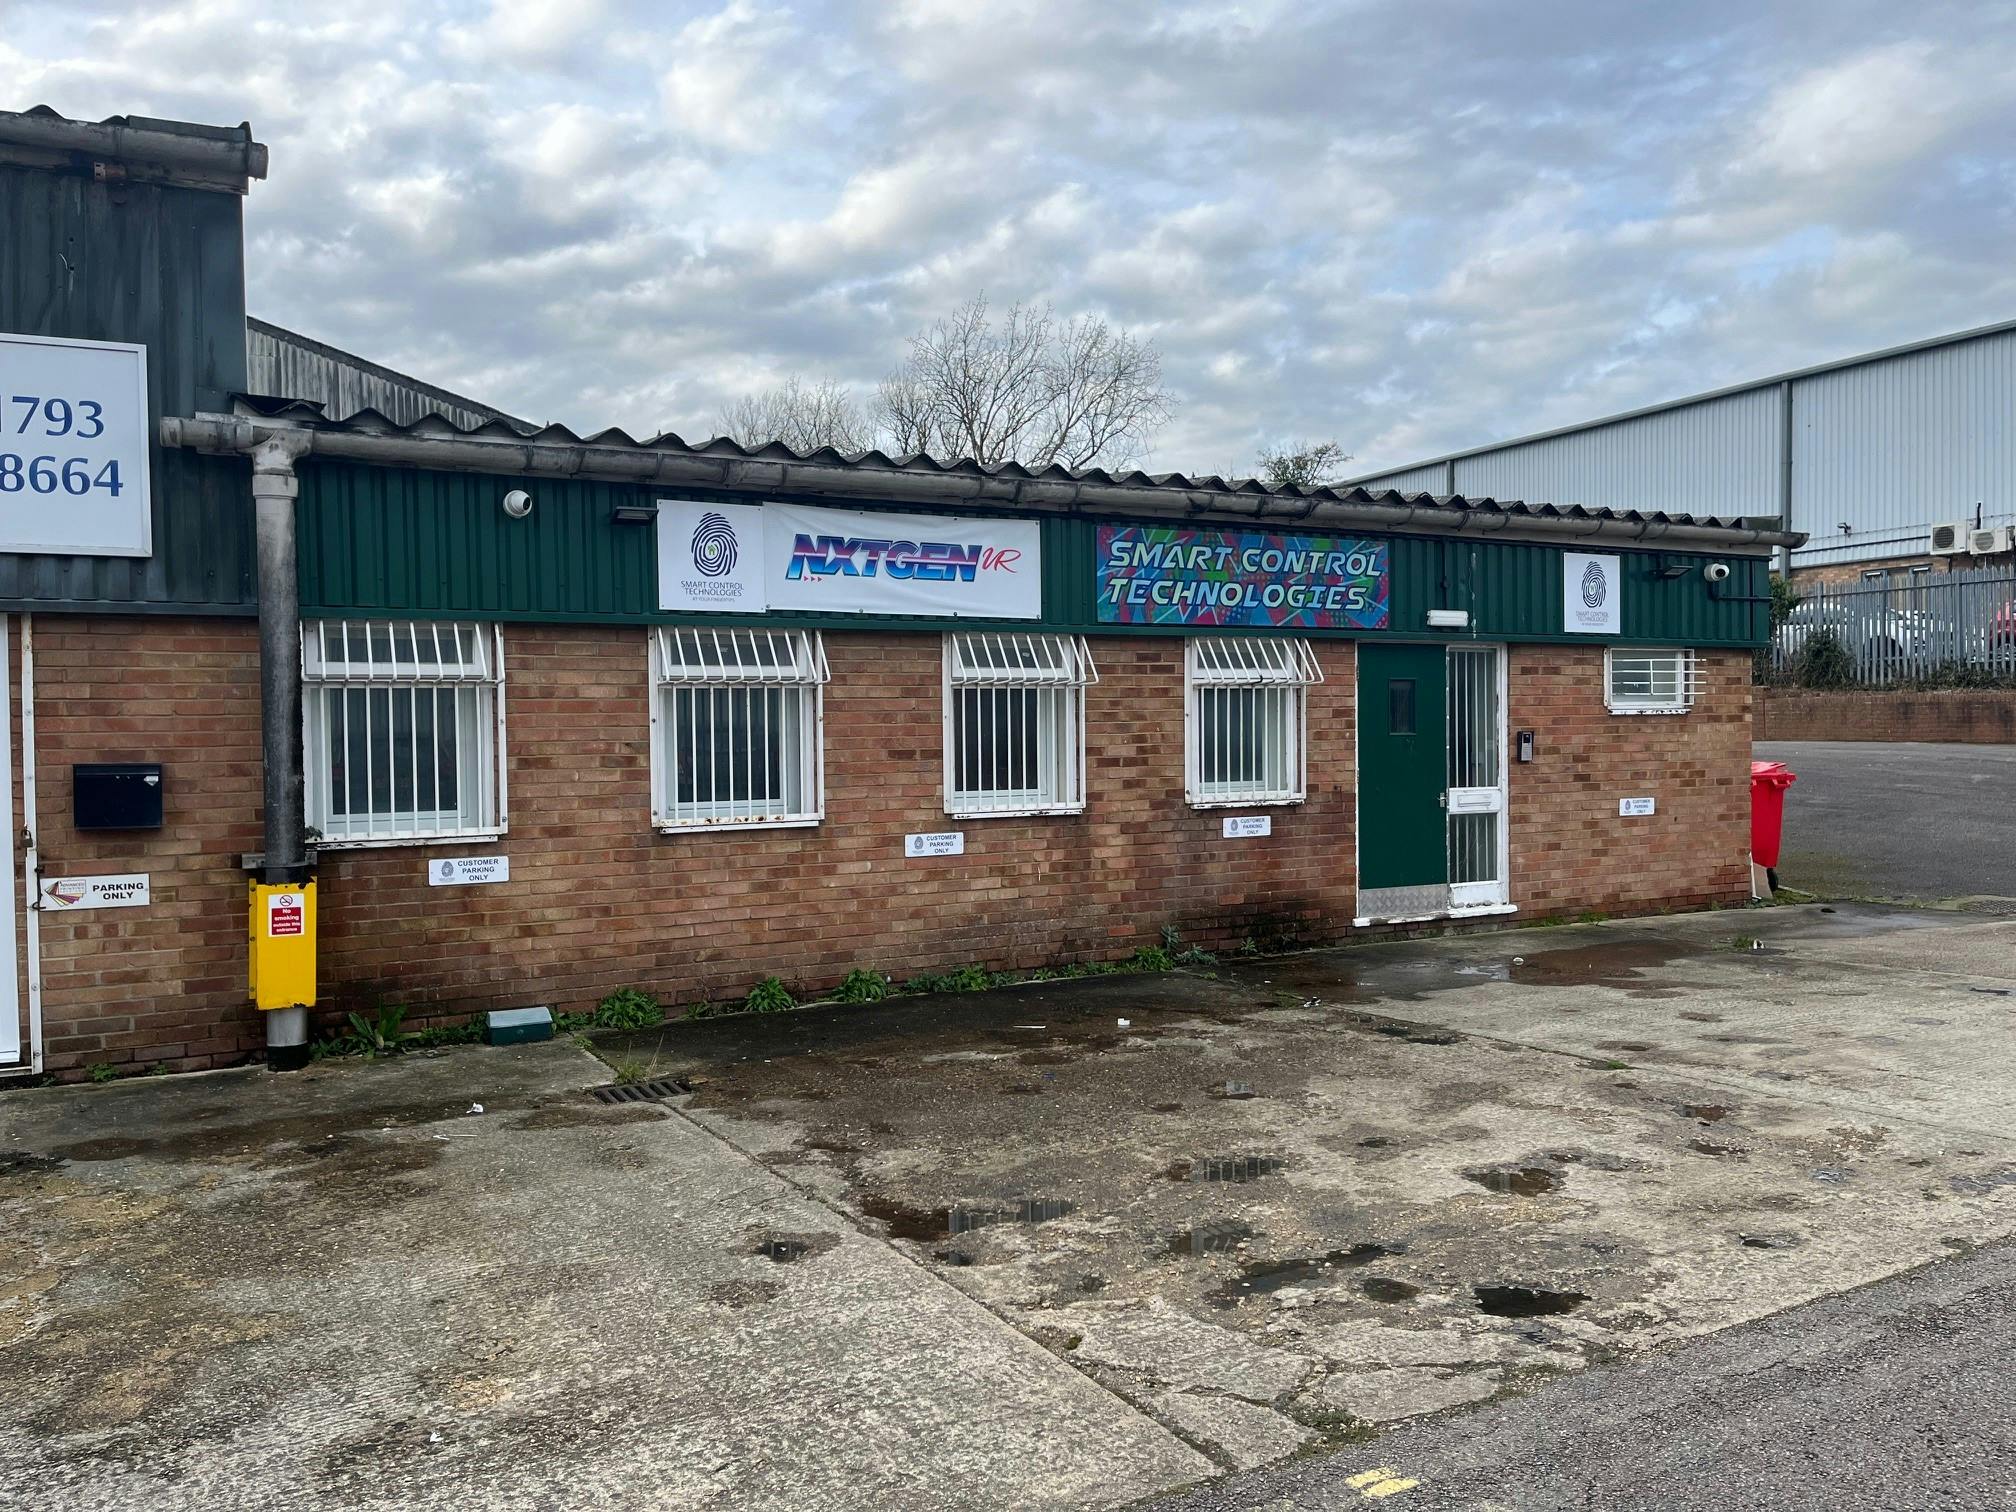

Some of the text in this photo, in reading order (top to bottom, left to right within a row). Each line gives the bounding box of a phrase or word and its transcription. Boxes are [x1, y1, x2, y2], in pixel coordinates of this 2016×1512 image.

[0, 394, 105, 439] 793
[0, 453, 124, 497] 8664
[785, 533, 1022, 582] NXTGEN VR
[1107, 541, 1385, 577] SMART CONTROL
[680, 580, 745, 590] SMART CONTROL
[684, 587, 743, 597] TECHNOLOGIES
[1107, 577, 1367, 611] TECHNOLOGIES
[457, 858, 499, 867] CUSTOMER
[462, 866, 495, 874] PARKING
[92, 882, 144, 892] PARKING
[102, 891, 134, 900] ONLY
